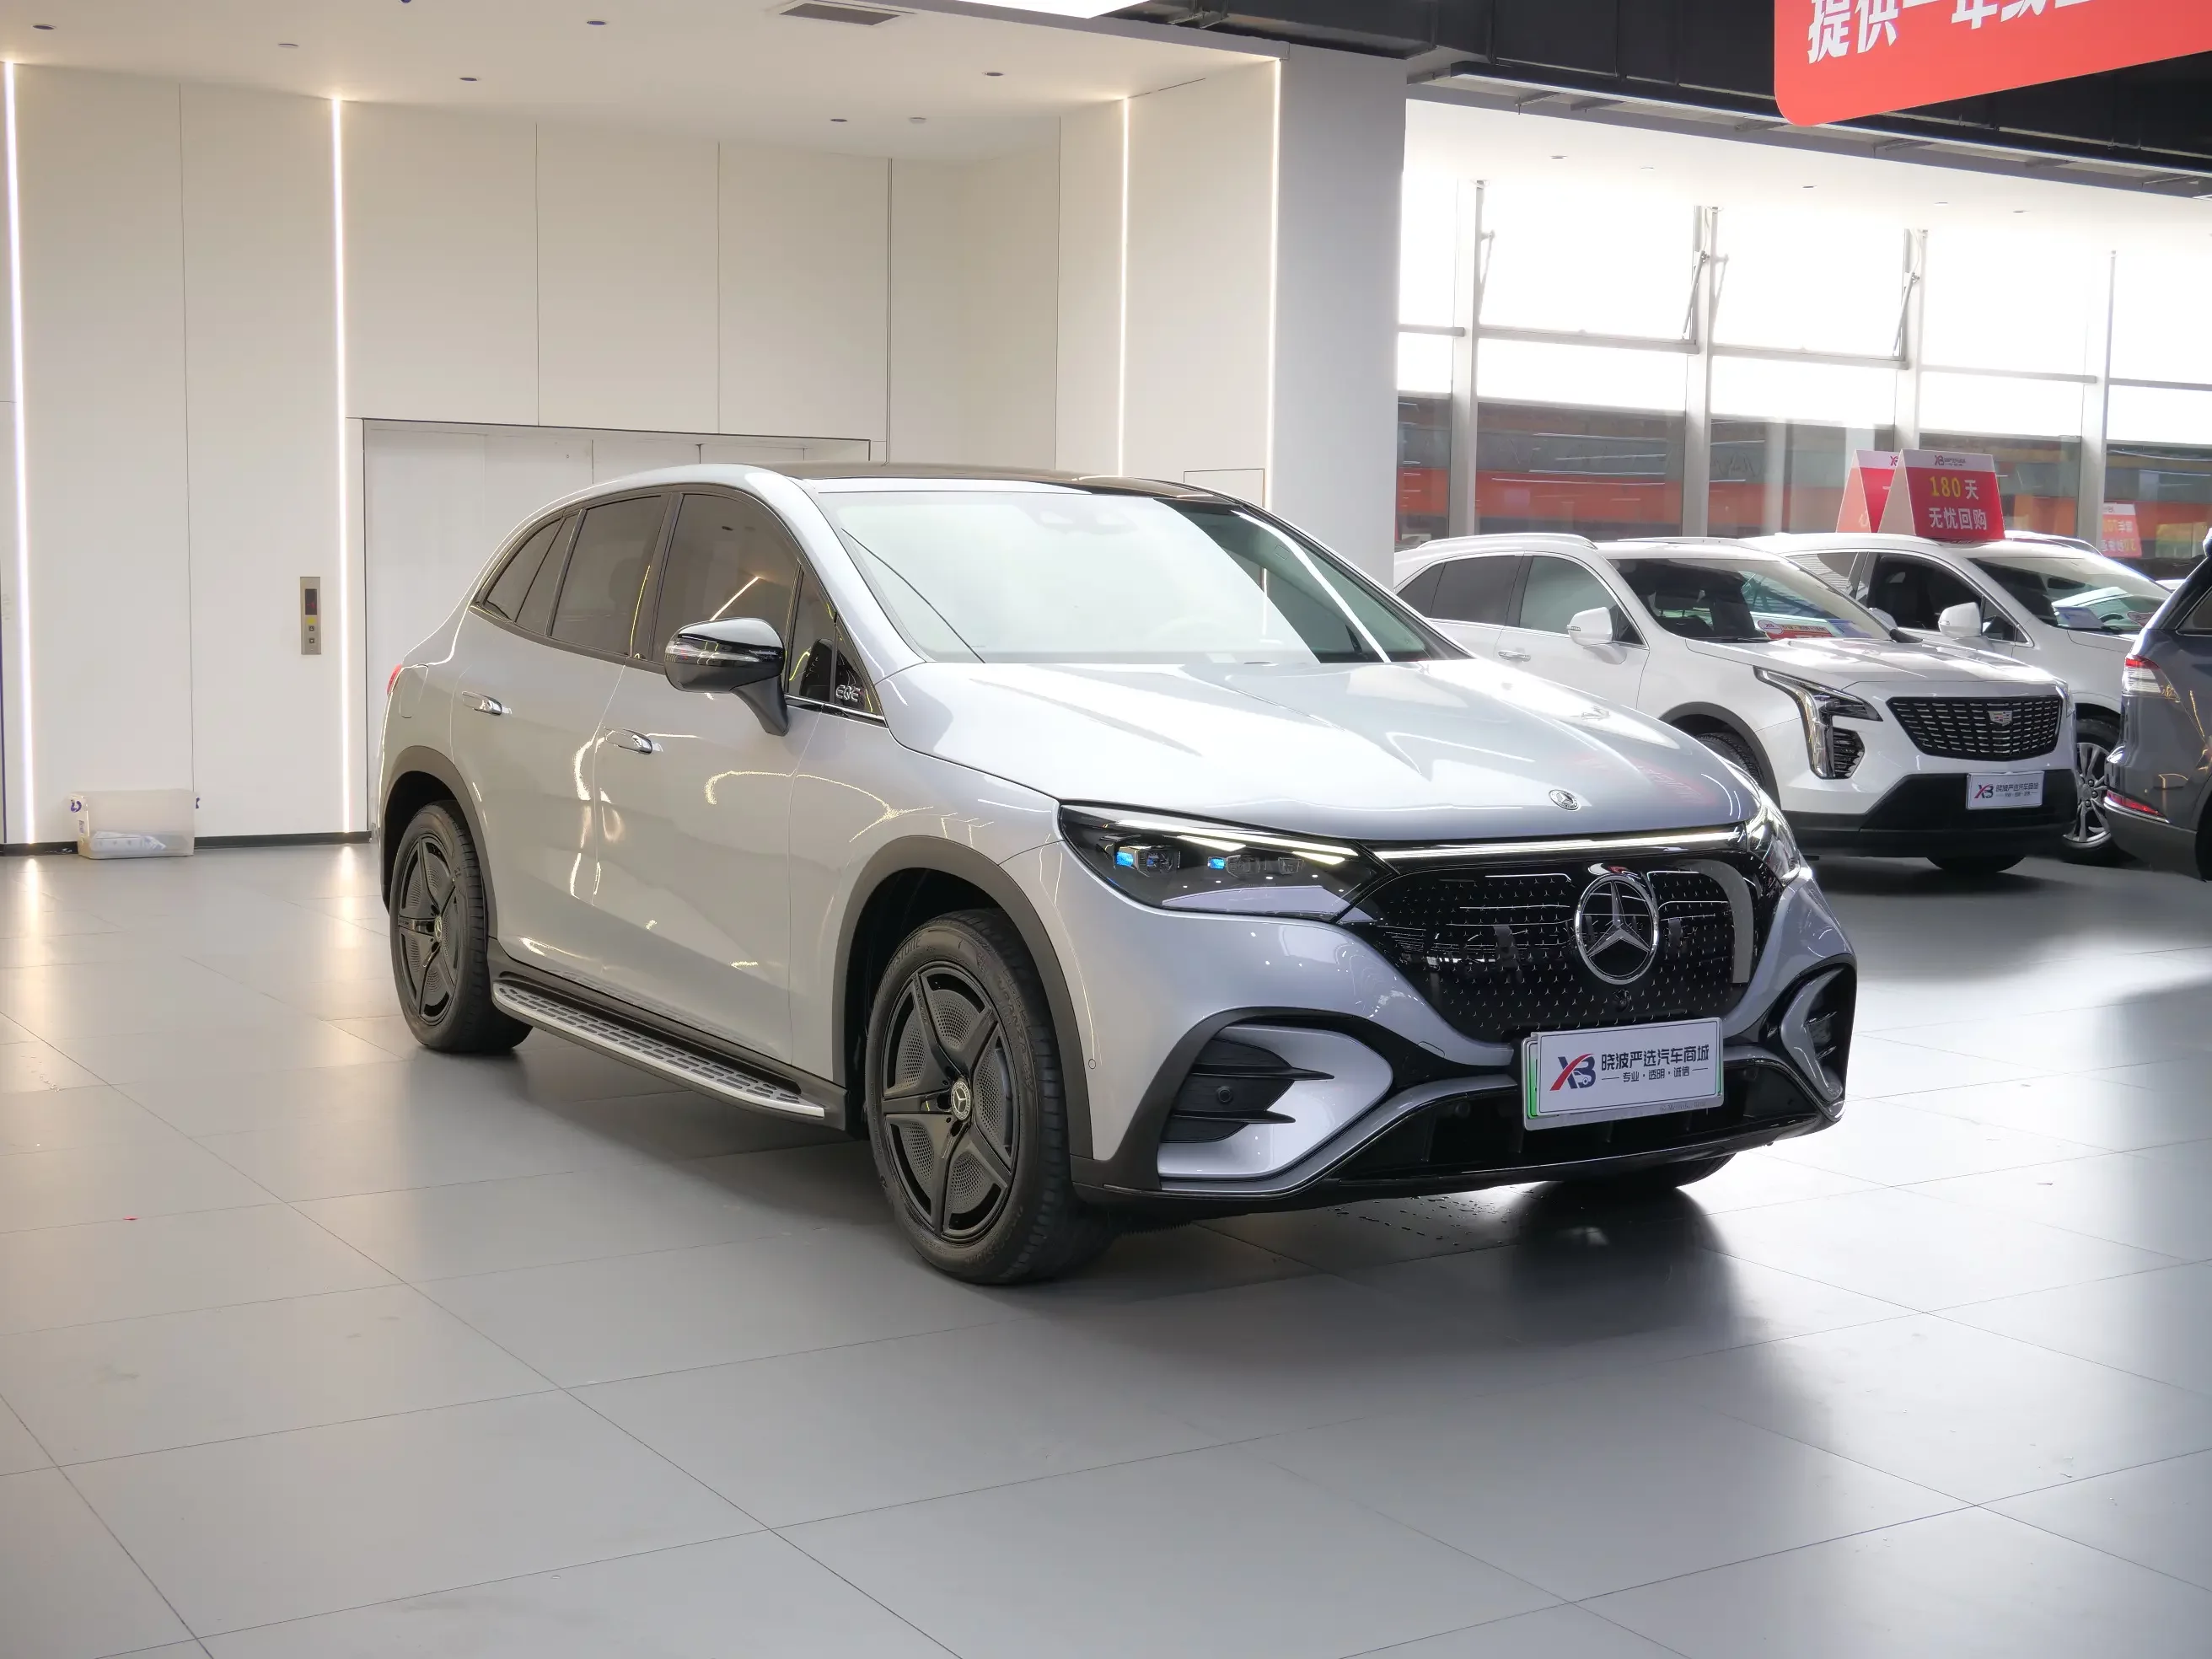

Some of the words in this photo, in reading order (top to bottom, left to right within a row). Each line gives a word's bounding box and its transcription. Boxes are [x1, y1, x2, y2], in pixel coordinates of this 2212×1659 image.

[1928, 507, 1988, 530] 无忧回购
[835, 684, 861, 702] EQE
[1601, 1044, 1710, 1071] 晓波严选汽车商城
